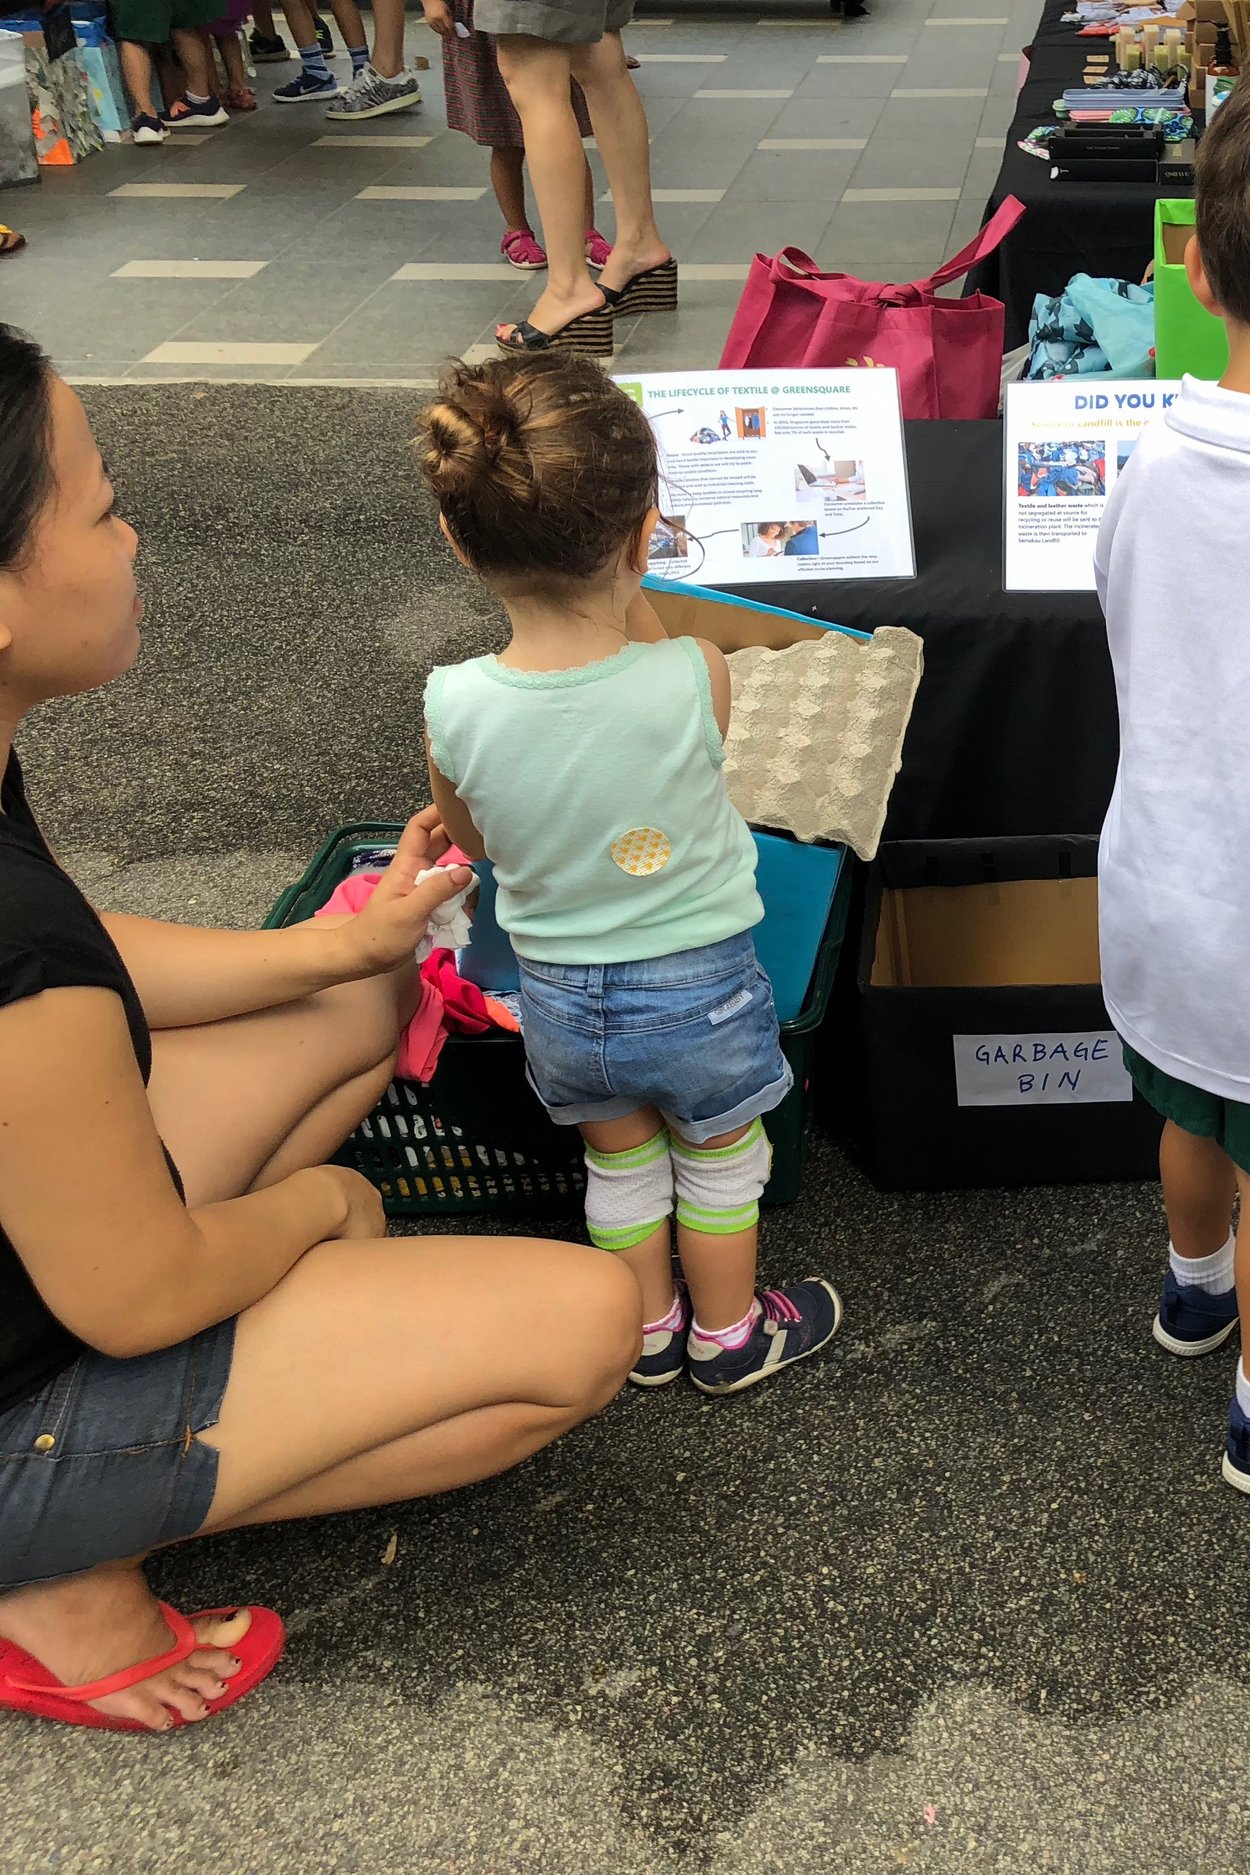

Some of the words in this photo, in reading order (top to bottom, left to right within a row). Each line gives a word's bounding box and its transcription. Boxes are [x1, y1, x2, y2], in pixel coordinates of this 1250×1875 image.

[647, 390, 666, 398] THE
[669, 387, 715, 397] LIFECYCLE
[717, 387, 729, 395] OF
[732, 386, 768, 395] TEXTILE
[771, 386, 780, 395] @
[782, 385, 851, 394] GREENSQUARE
[1075, 395, 1108, 409] DID
[1114, 394, 1155, 408] YOU
[1078, 419, 1112, 428] Landfill
[976, 1038, 1108, 1065] GARBAGE
[1018, 1069, 1081, 1092] BIN
